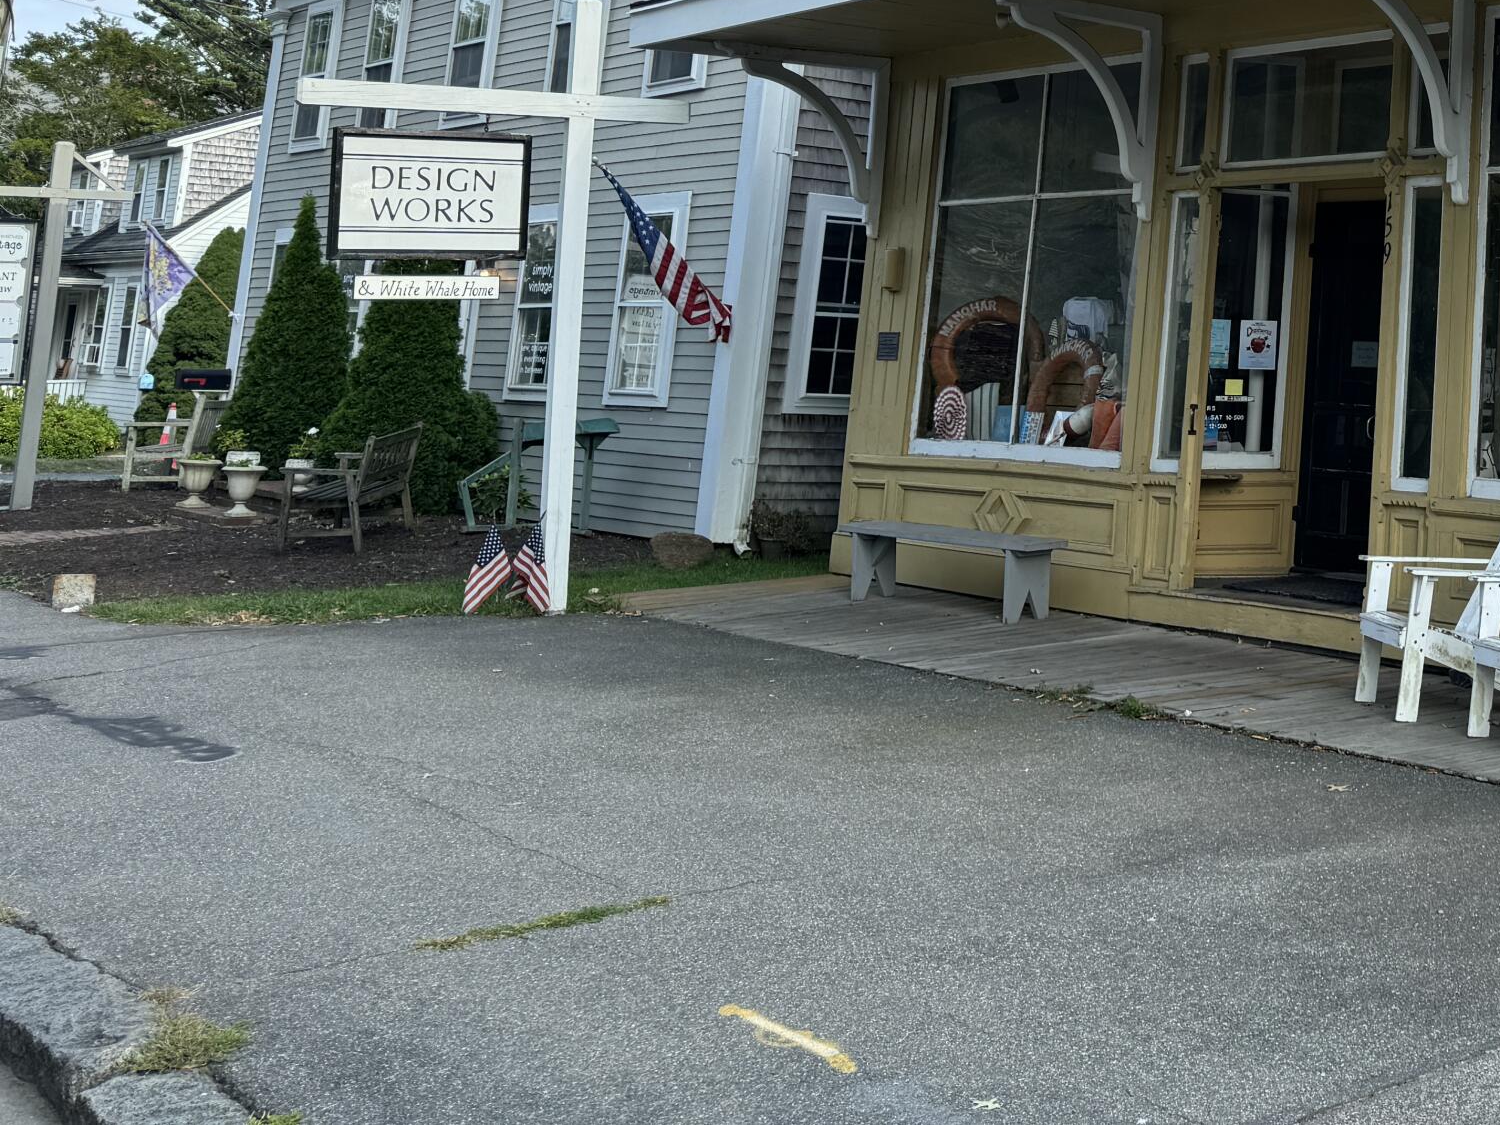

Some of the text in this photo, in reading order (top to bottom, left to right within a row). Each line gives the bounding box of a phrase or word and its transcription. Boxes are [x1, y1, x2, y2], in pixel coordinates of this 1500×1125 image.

[371, 165, 496, 192] DESIGN
[370, 196, 494, 223] WORKS
[1383, 191, 1393, 264] 159
[532, 264, 553, 280] simply
[358, 280, 374, 296] &
[380, 279, 420, 296] White
[425, 280, 460, 297] Whale
[461, 281, 494, 297] Home
[528, 281, 553, 295] vintage
